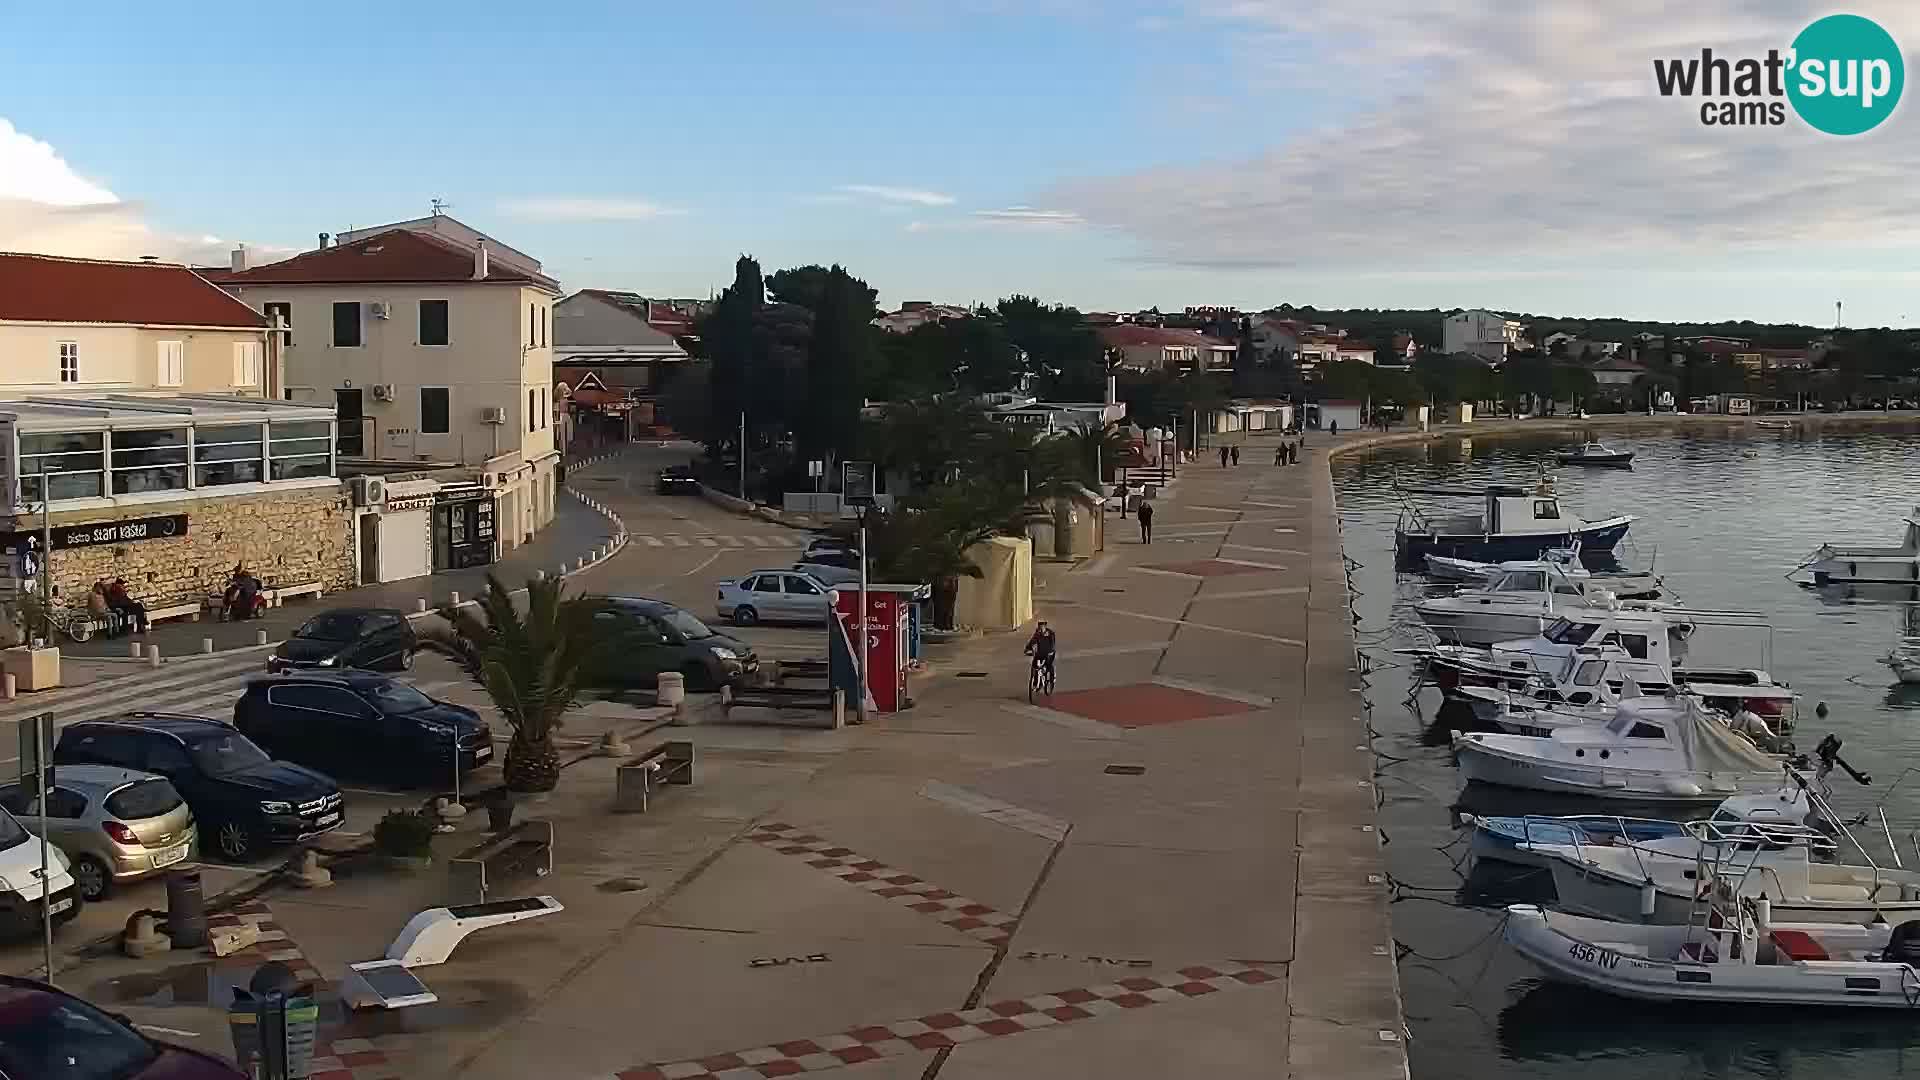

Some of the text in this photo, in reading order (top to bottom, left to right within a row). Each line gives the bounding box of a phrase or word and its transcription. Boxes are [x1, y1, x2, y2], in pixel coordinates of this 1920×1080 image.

[389, 500, 428, 511] MARKET
[67, 532, 91, 544] bistro
[1568, 943, 1597, 962] 456
[1598, 951, 1620, 969] NV
